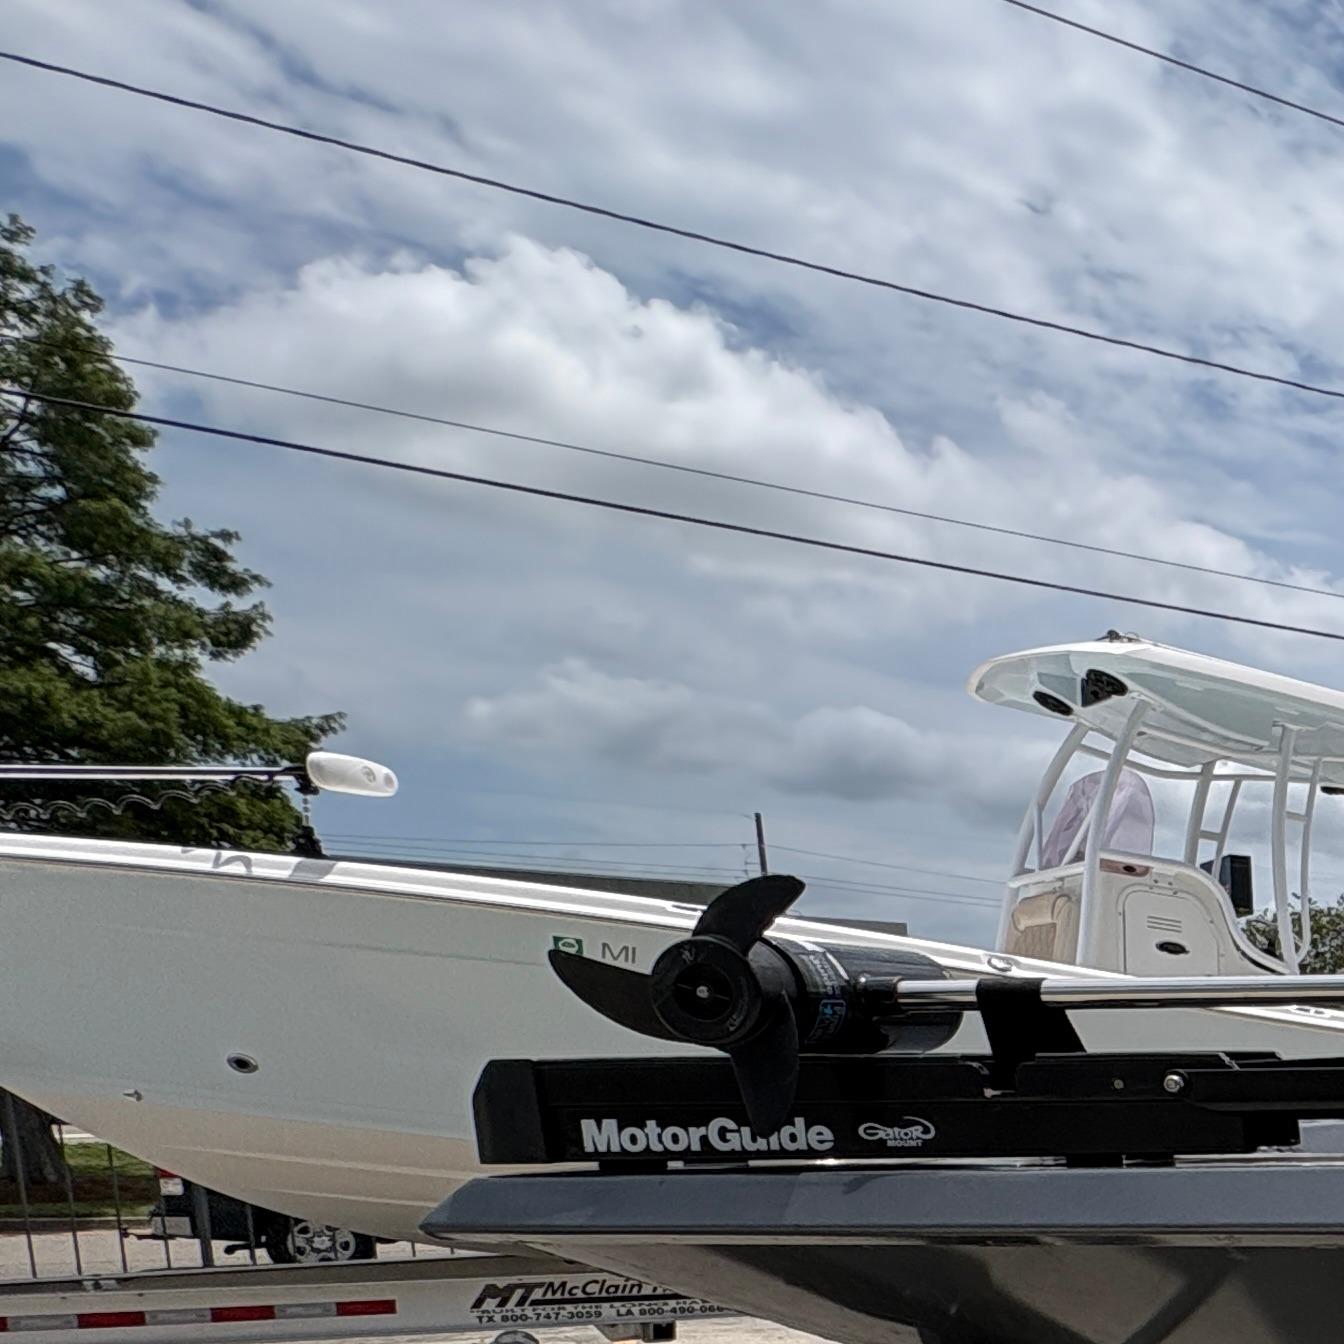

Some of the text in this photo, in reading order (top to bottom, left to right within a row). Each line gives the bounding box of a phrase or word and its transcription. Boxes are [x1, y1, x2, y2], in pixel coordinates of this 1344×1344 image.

[580, 1117, 834, 1152] MotorGuide
[542, 1278, 642, 1298] McClain
[477, 1315, 496, 1325] TX
[501, 1310, 603, 1323] 800-747-3059
[616, 1308, 635, 1317] LA
